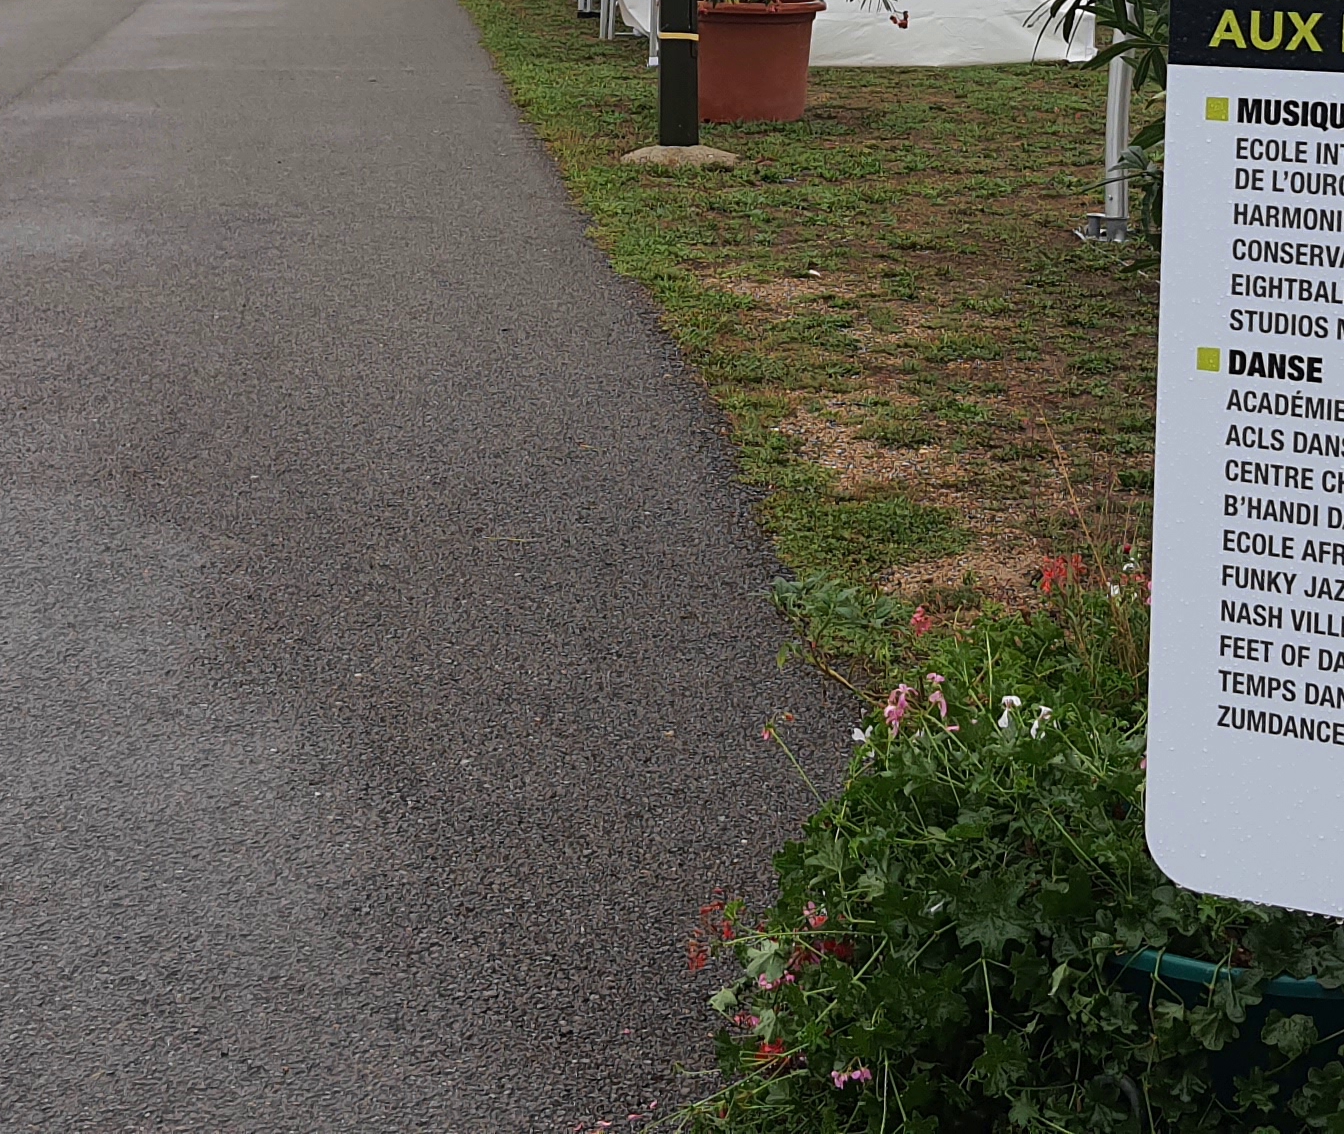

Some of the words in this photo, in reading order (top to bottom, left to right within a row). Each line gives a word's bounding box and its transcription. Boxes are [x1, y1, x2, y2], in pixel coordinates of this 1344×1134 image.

[1208, 8, 1323, 53] AUX
[1235, 137, 1308, 163] ECOLE
[1235, 168, 1265, 192] DE
[1229, 308, 1329, 341] STUDIOS
[1228, 349, 1323, 383] DANSE
[1225, 424, 1285, 453] ACLS
[1225, 460, 1314, 491] CENTRE
[1224, 495, 1319, 528] B'HANDI
[1222, 530, 1295, 560] ECOLE
[1221, 565, 1297, 596] FUNKY
[1220, 600, 1283, 630] NASH
[1219, 635, 1273, 664] FEET
[1281, 644, 1311, 669] OF
[1218, 670, 1297, 703] TEMPS
